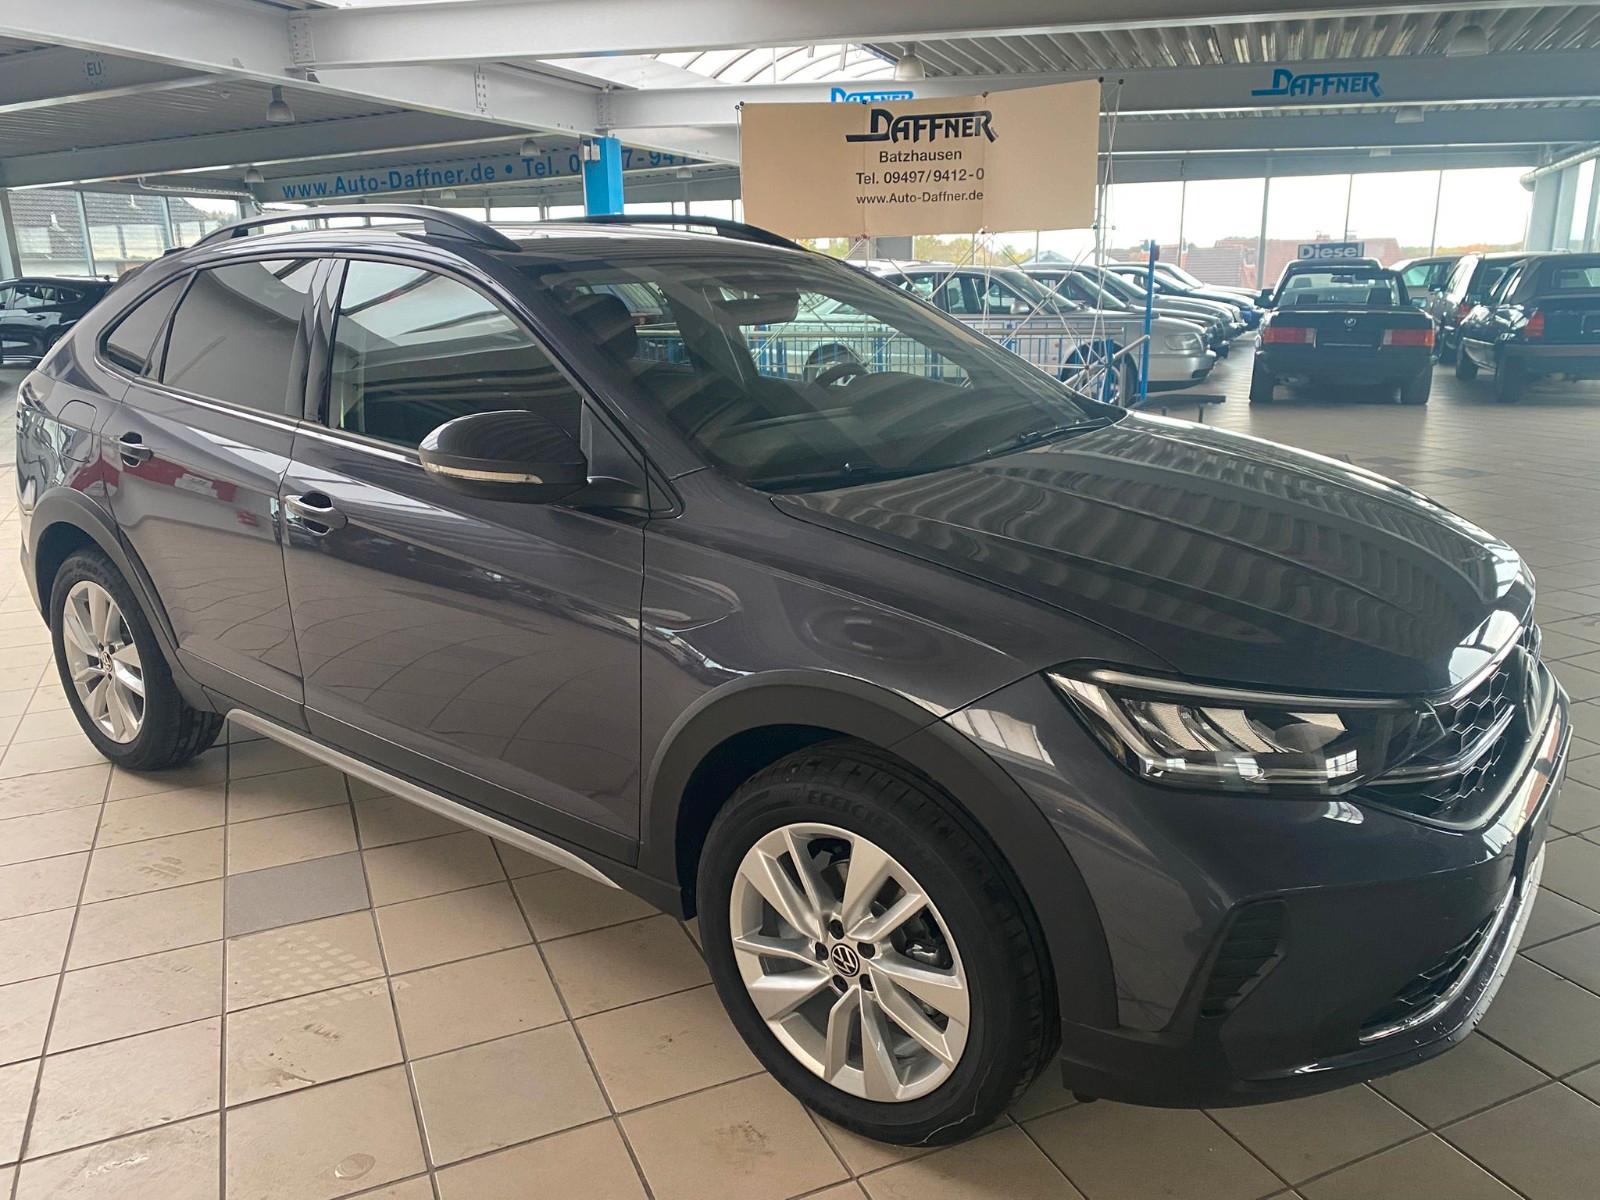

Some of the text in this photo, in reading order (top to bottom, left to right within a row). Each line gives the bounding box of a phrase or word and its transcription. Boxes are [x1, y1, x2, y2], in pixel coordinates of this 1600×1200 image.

[87, 61, 102, 77] EU
[1251, 68, 1384, 98] DAFFNER
[846, 108, 999, 144] DAFFNER
[879, 150, 963, 164] Batzhausen
[282, 162, 497, 200] www.Auto-Daffner.de
[522, 156, 560, 178] Tel.
[856, 168, 985, 185] Tel. 09497/9412-0
[856, 189, 984, 205] www.Auto-Daffner.de
[1299, 242, 1364, 260] Diesel
